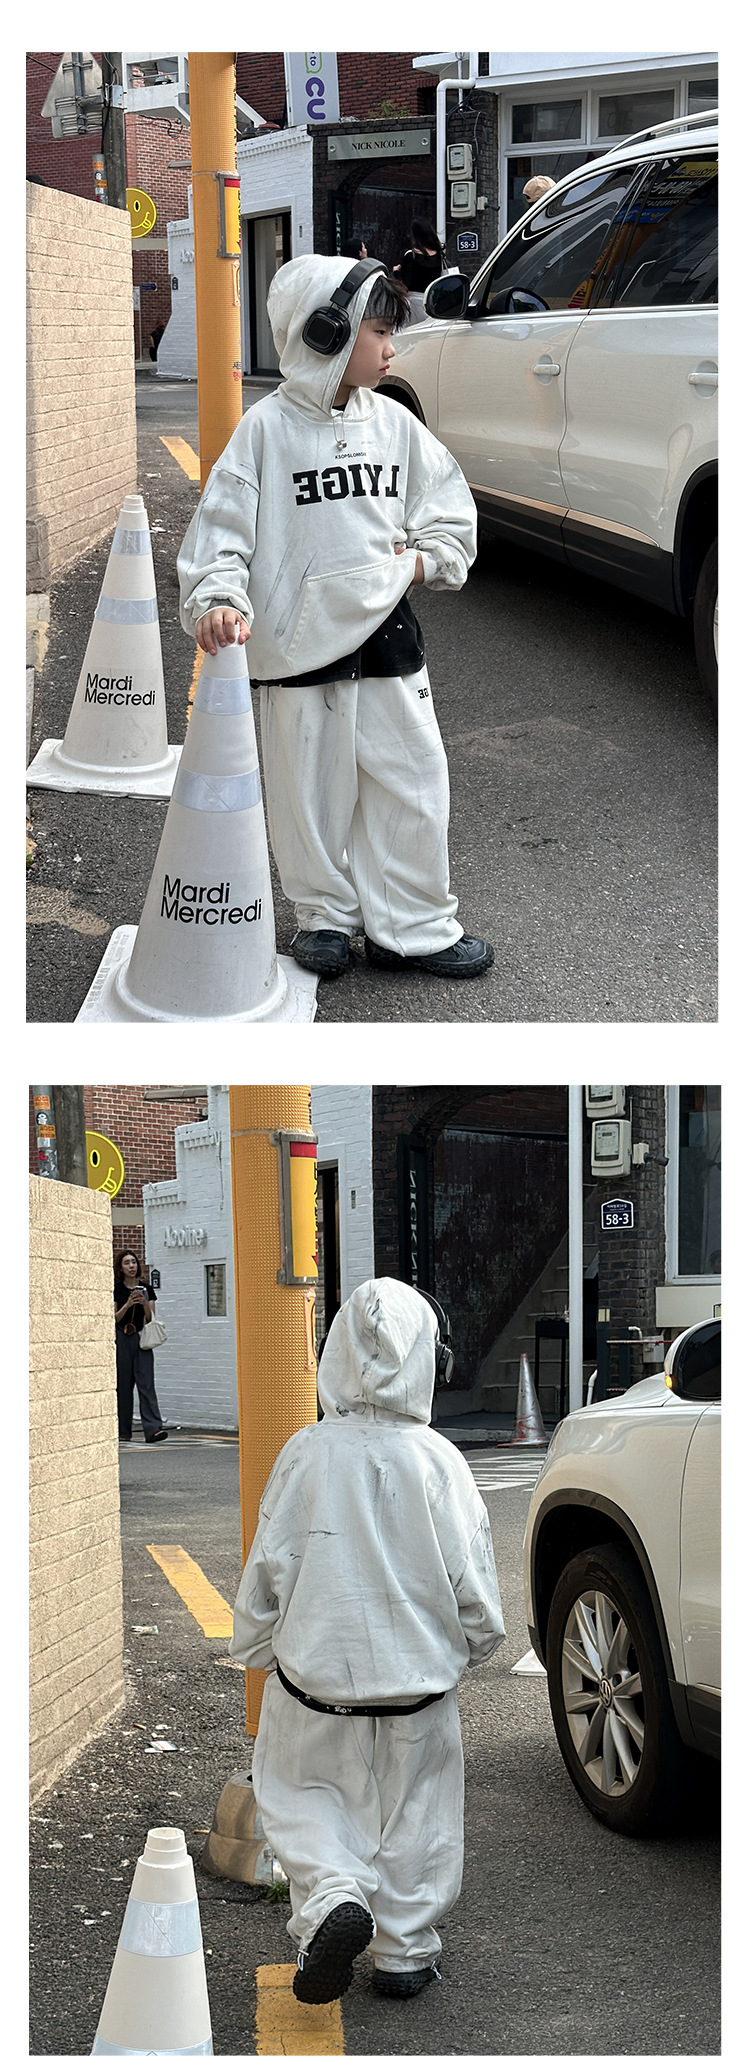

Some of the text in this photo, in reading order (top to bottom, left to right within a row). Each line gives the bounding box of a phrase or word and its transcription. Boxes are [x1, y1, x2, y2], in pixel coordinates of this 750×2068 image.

[305, 76, 326, 120] CU
[351, 139, 406, 151] NICK NICOLE
[460, 240, 475, 249] 58-3
[86, 673, 132, 691] Mardi
[84, 688, 156, 706] Mercredi
[163, 874, 231, 904] Mardi
[160, 895, 262, 926] Mercredi
[606, 1212, 629, 1226] 58-3
